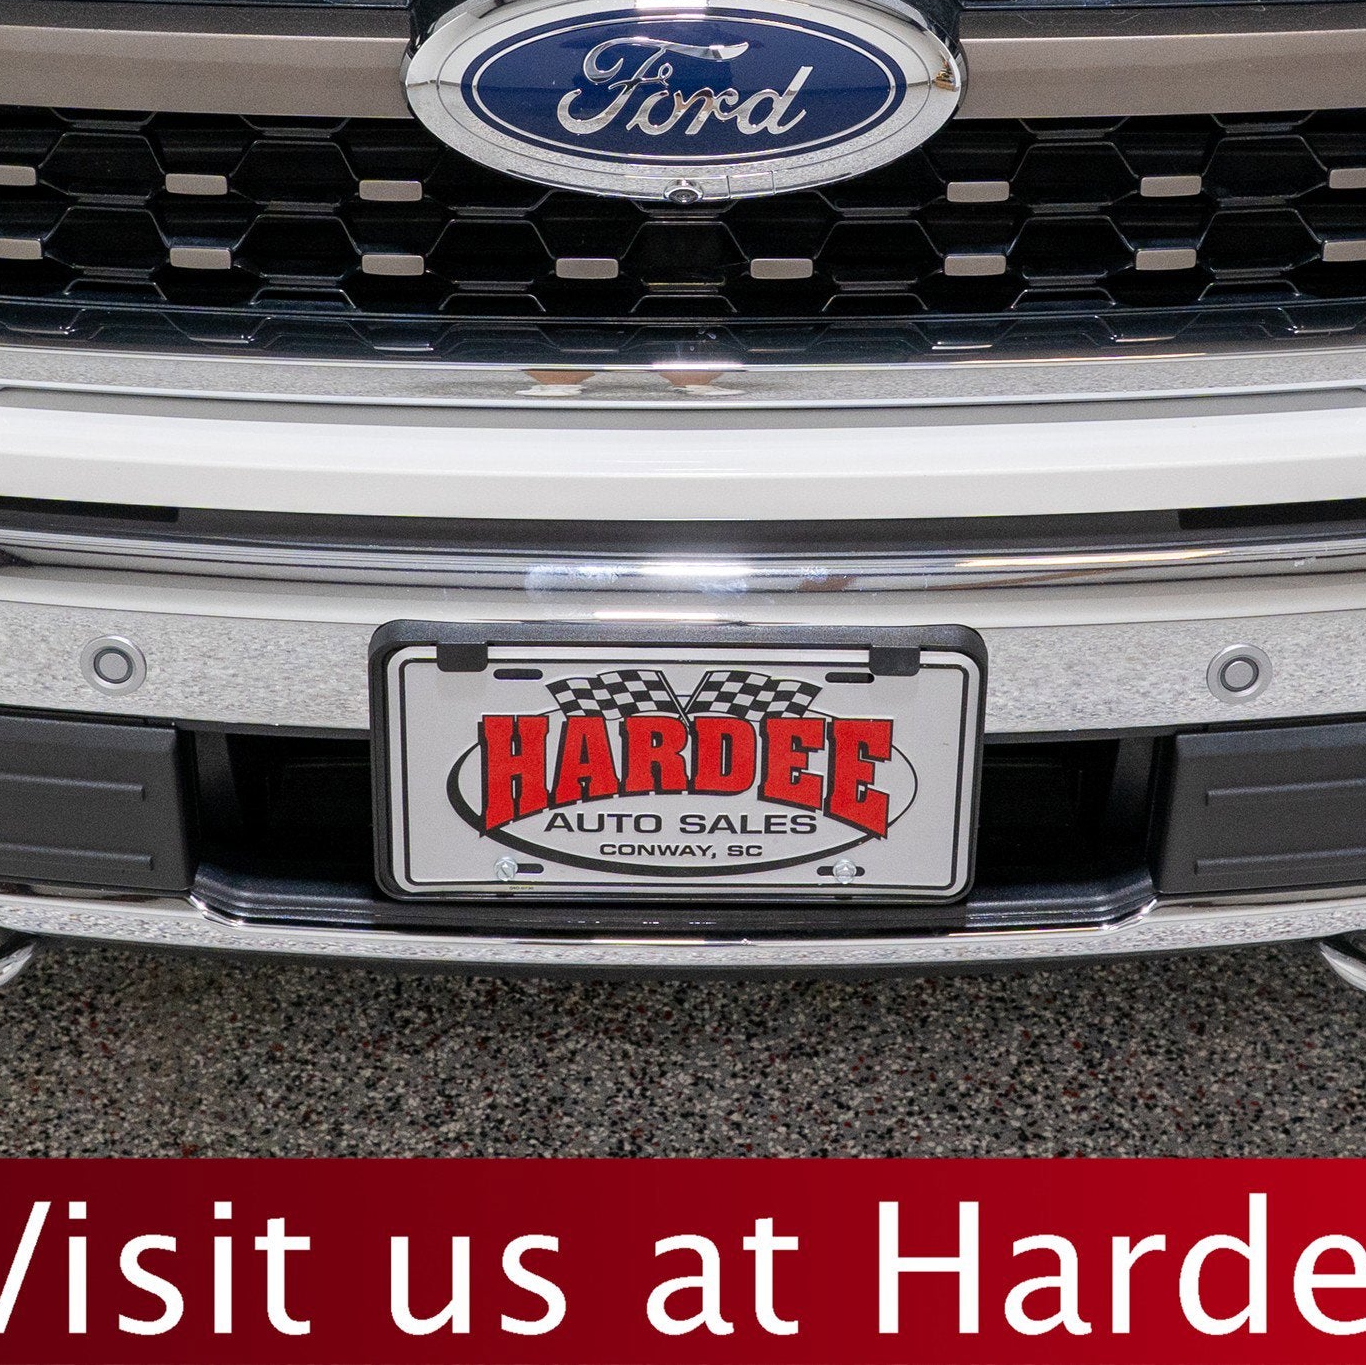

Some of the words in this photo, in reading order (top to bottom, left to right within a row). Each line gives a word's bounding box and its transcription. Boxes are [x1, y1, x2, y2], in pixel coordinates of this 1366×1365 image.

[557, 37, 814, 135] Ford
[479, 714, 894, 839] HARDEE
[544, 812, 663, 834] AUTO
[679, 813, 818, 835] SALES
[599, 843, 718, 860] CONWAY,
[727, 844, 764, 858] SC
